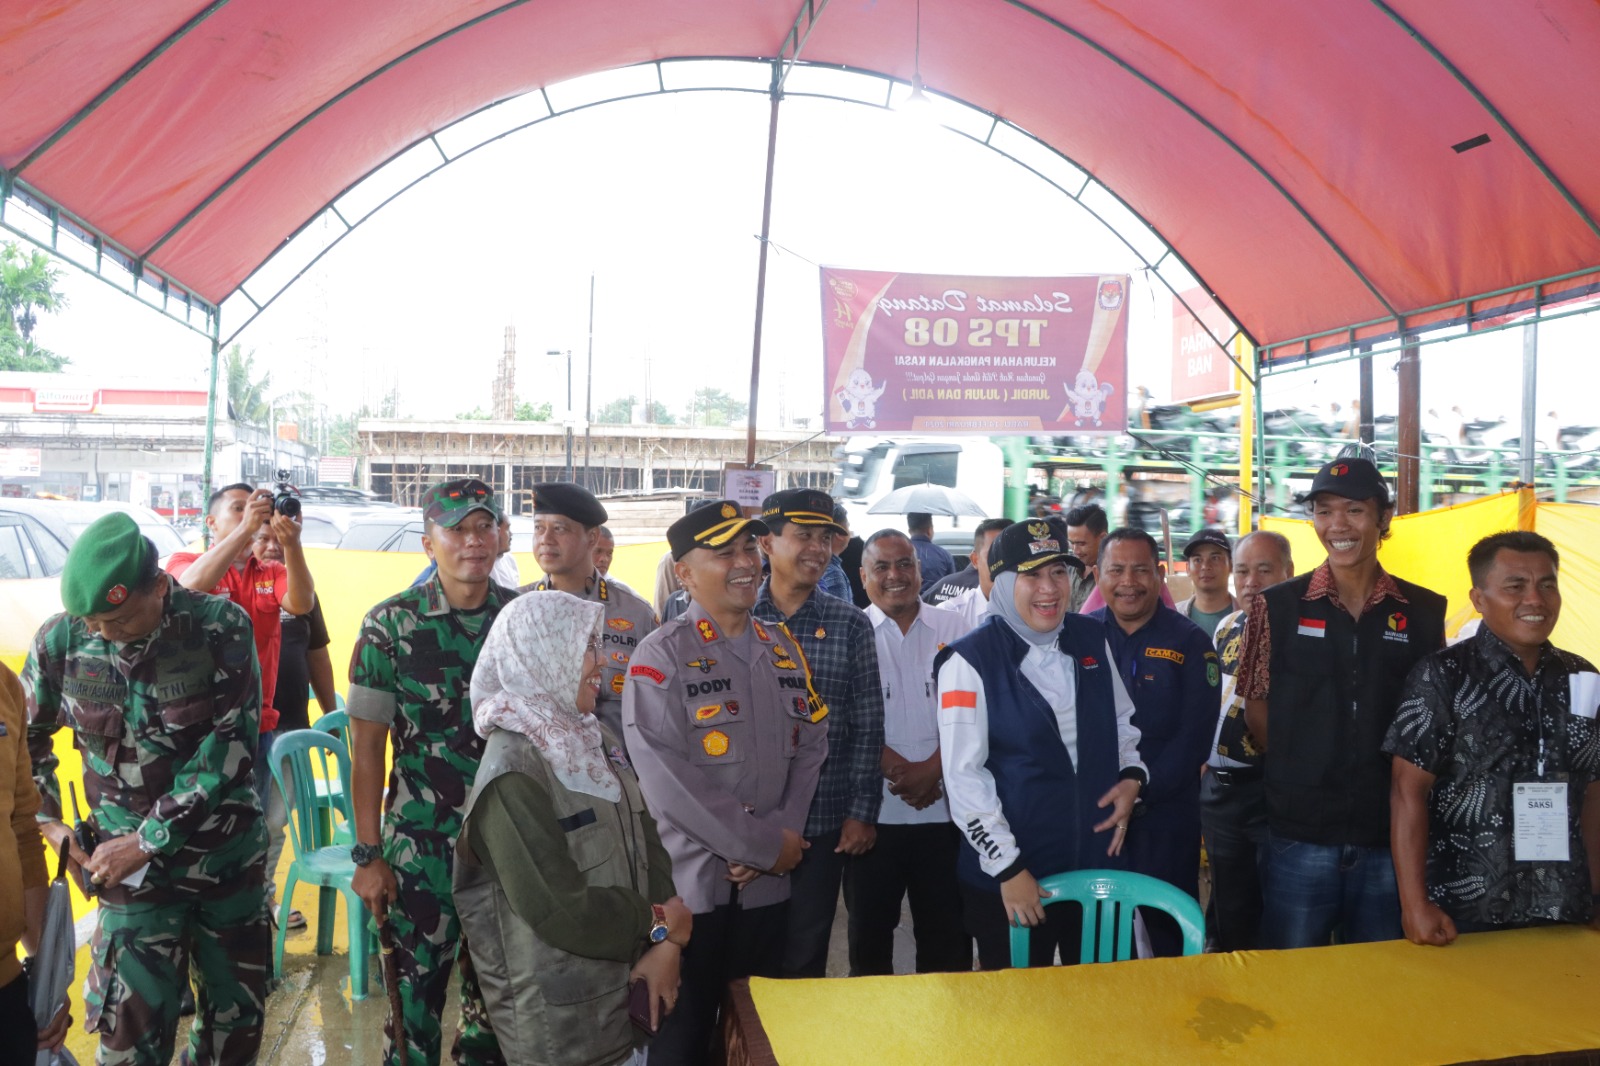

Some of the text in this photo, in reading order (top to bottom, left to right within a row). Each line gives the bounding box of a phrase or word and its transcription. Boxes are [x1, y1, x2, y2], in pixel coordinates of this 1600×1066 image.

[1187, 353, 1213, 378] BAN
[38, 391, 89, 401] Alfamart
[602, 633, 637, 648] POLRI
[1147, 650, 1182, 662] CAMAT
[687, 678, 732, 698] DODY
[1528, 801, 1553, 809] SAKSI
[967, 818, 1002, 860] INHU
